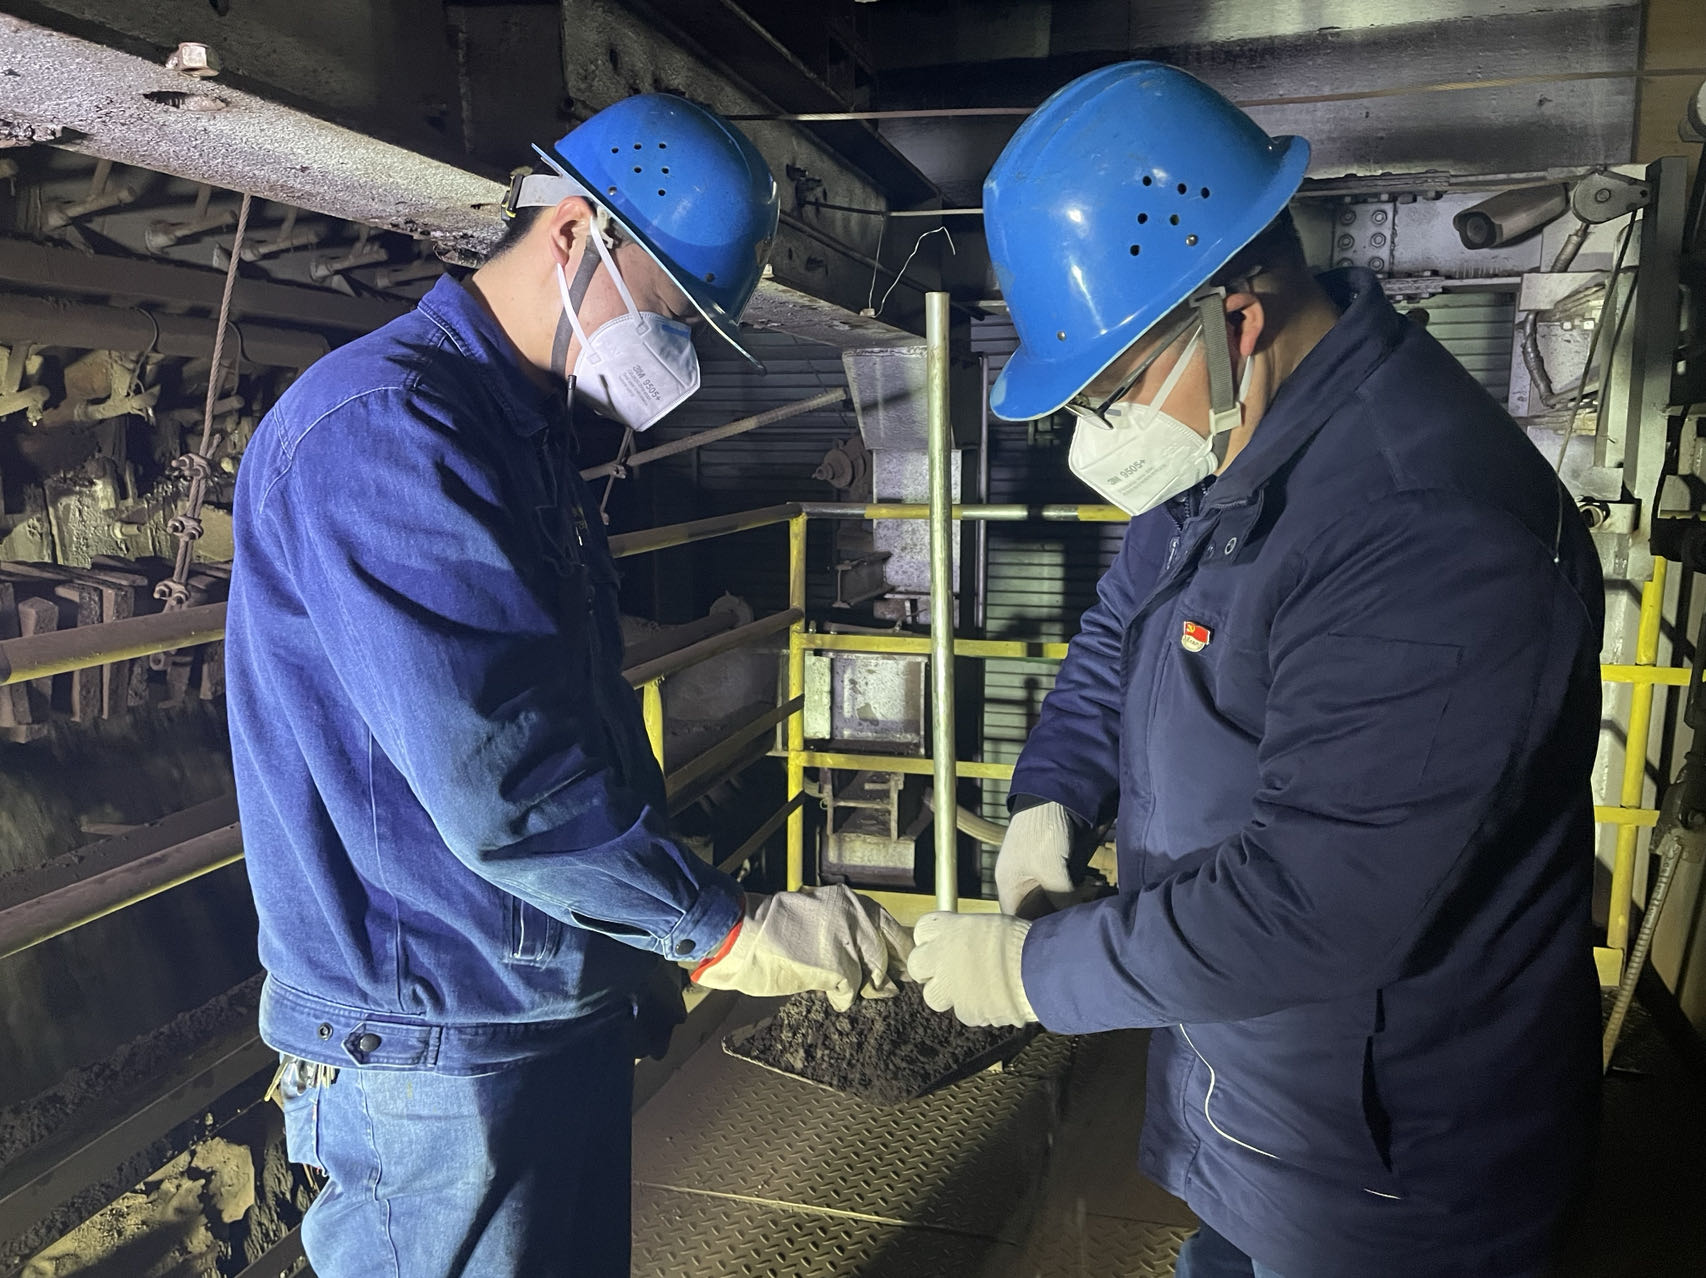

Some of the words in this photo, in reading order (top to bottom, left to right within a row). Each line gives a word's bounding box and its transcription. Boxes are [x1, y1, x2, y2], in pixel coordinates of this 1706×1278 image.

[632, 364, 646, 379] 3M
[643, 379, 661, 401] 9505+
[1107, 475, 1122, 486] 3M
[1119, 459, 1146, 479] 9505+
